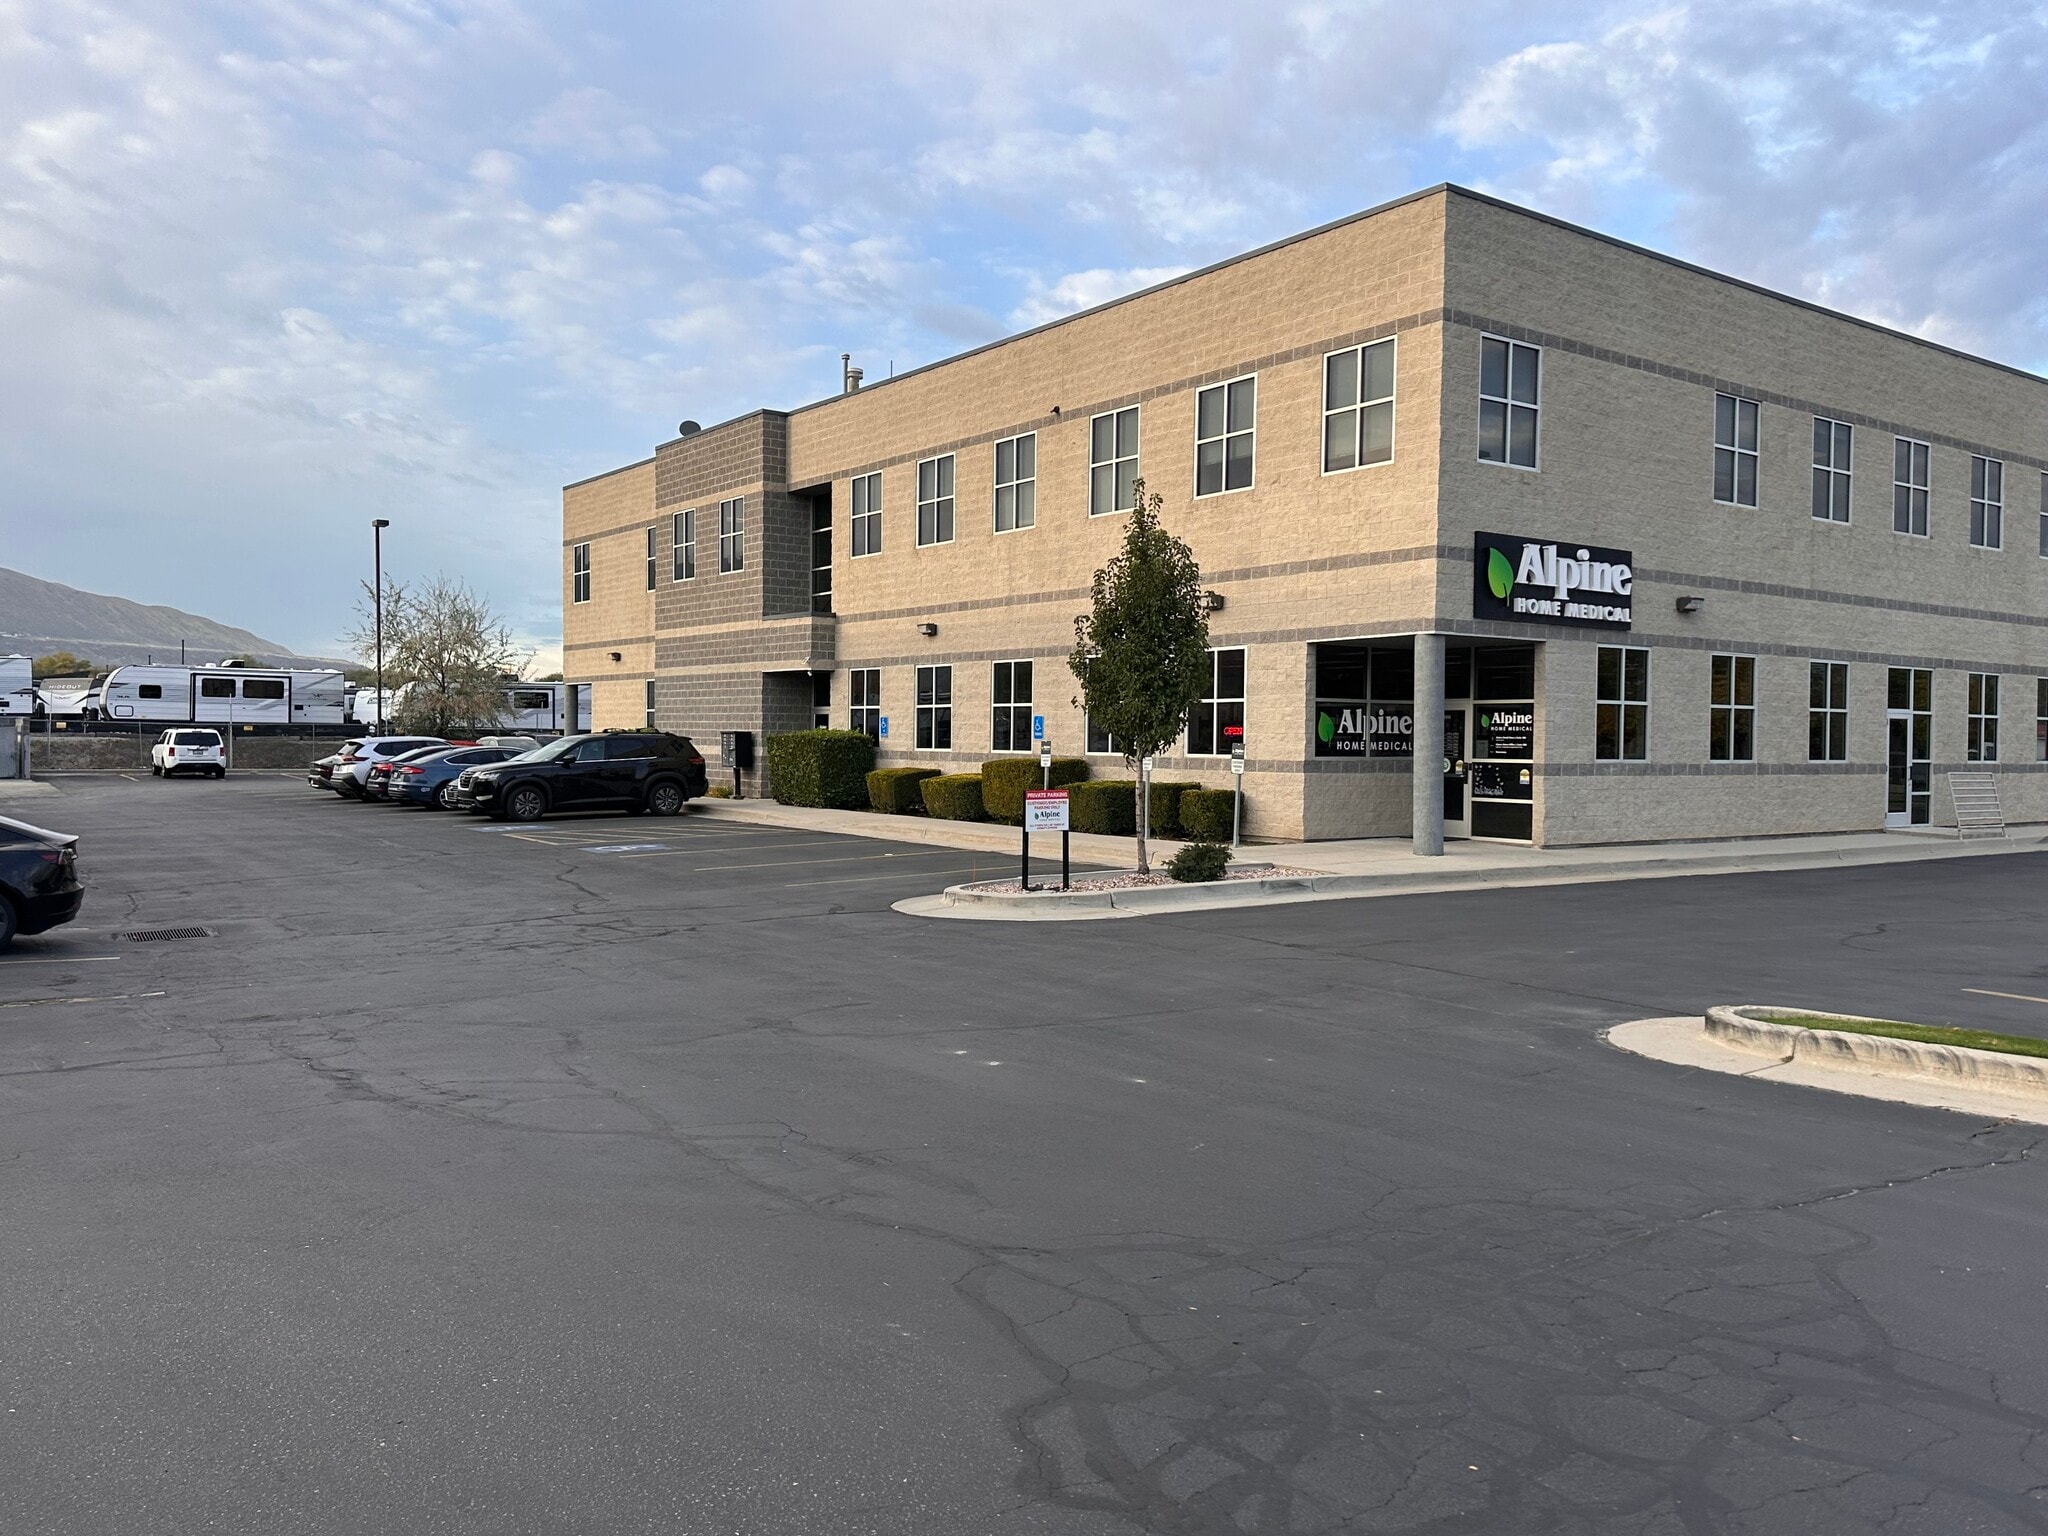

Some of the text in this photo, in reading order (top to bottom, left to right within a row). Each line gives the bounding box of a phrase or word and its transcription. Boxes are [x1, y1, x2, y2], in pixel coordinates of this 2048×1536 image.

[1514, 543, 1632, 600] Alpine
[1513, 597, 1632, 622] HOME MEDICAL
[1337, 708, 1413, 740] Alpine
[1491, 712, 1532, 726] Alpine
[1336, 741, 1413, 751] HOME MEDICAL
